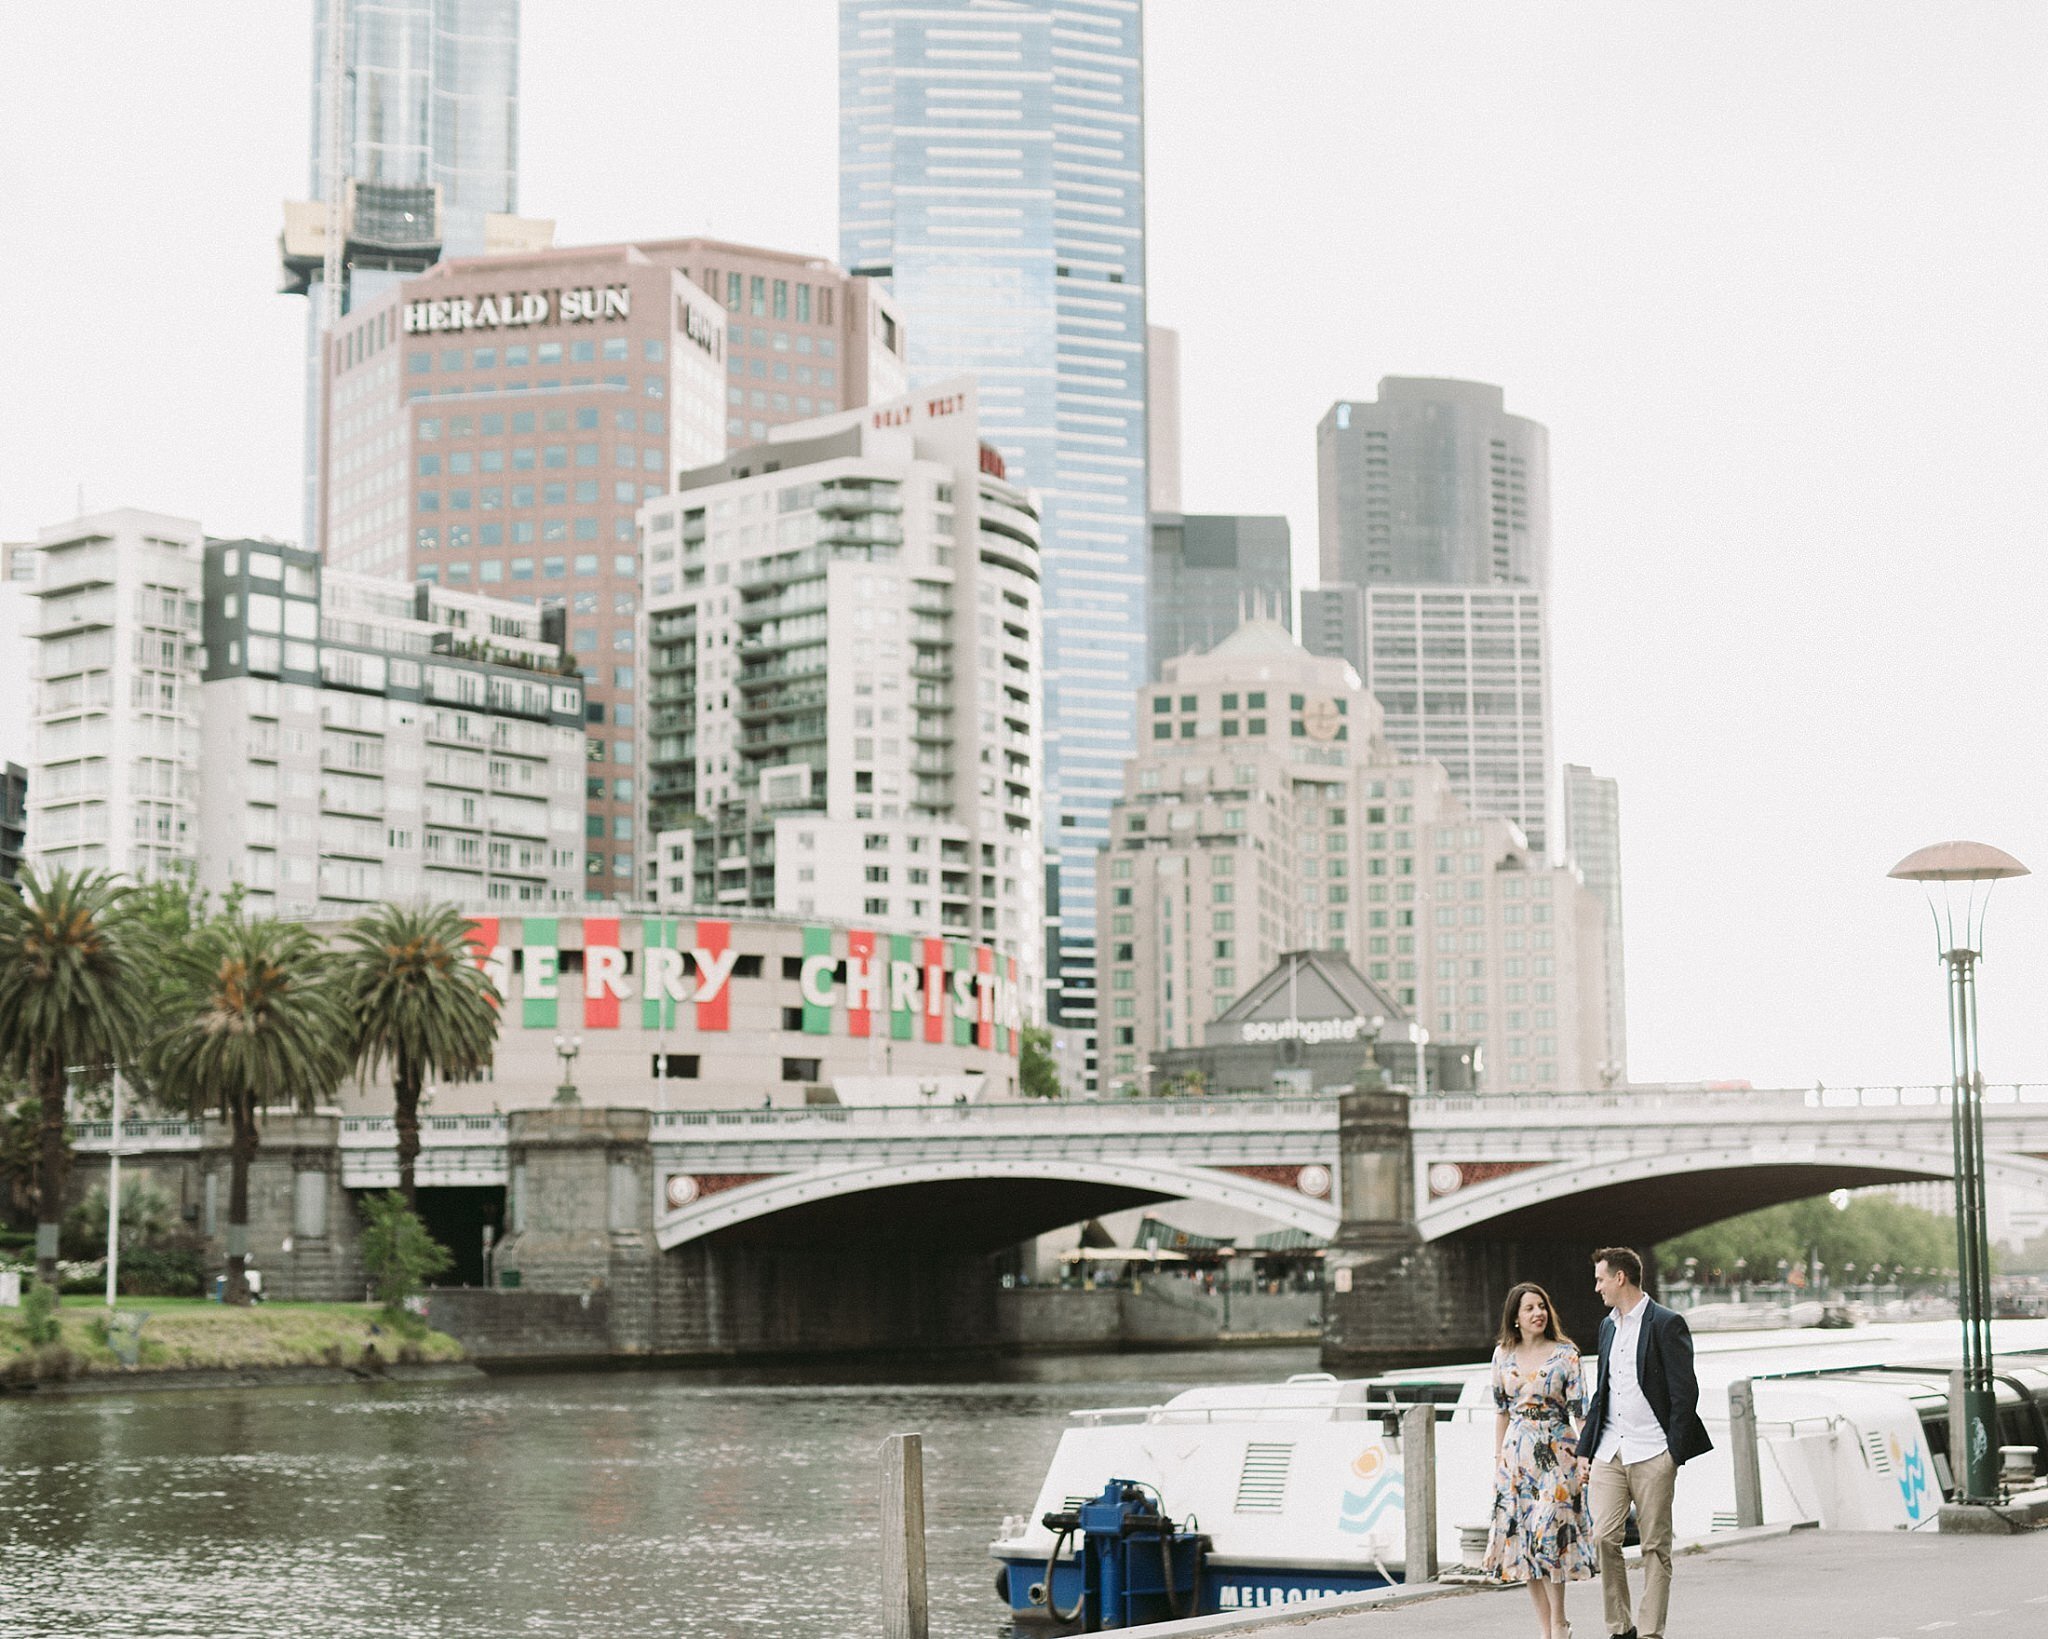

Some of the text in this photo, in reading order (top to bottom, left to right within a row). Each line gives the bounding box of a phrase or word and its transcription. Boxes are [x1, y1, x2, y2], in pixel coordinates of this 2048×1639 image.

[403, 288, 631, 332] HERALD SUN
[1242, 1017, 1358, 1045] southgate
